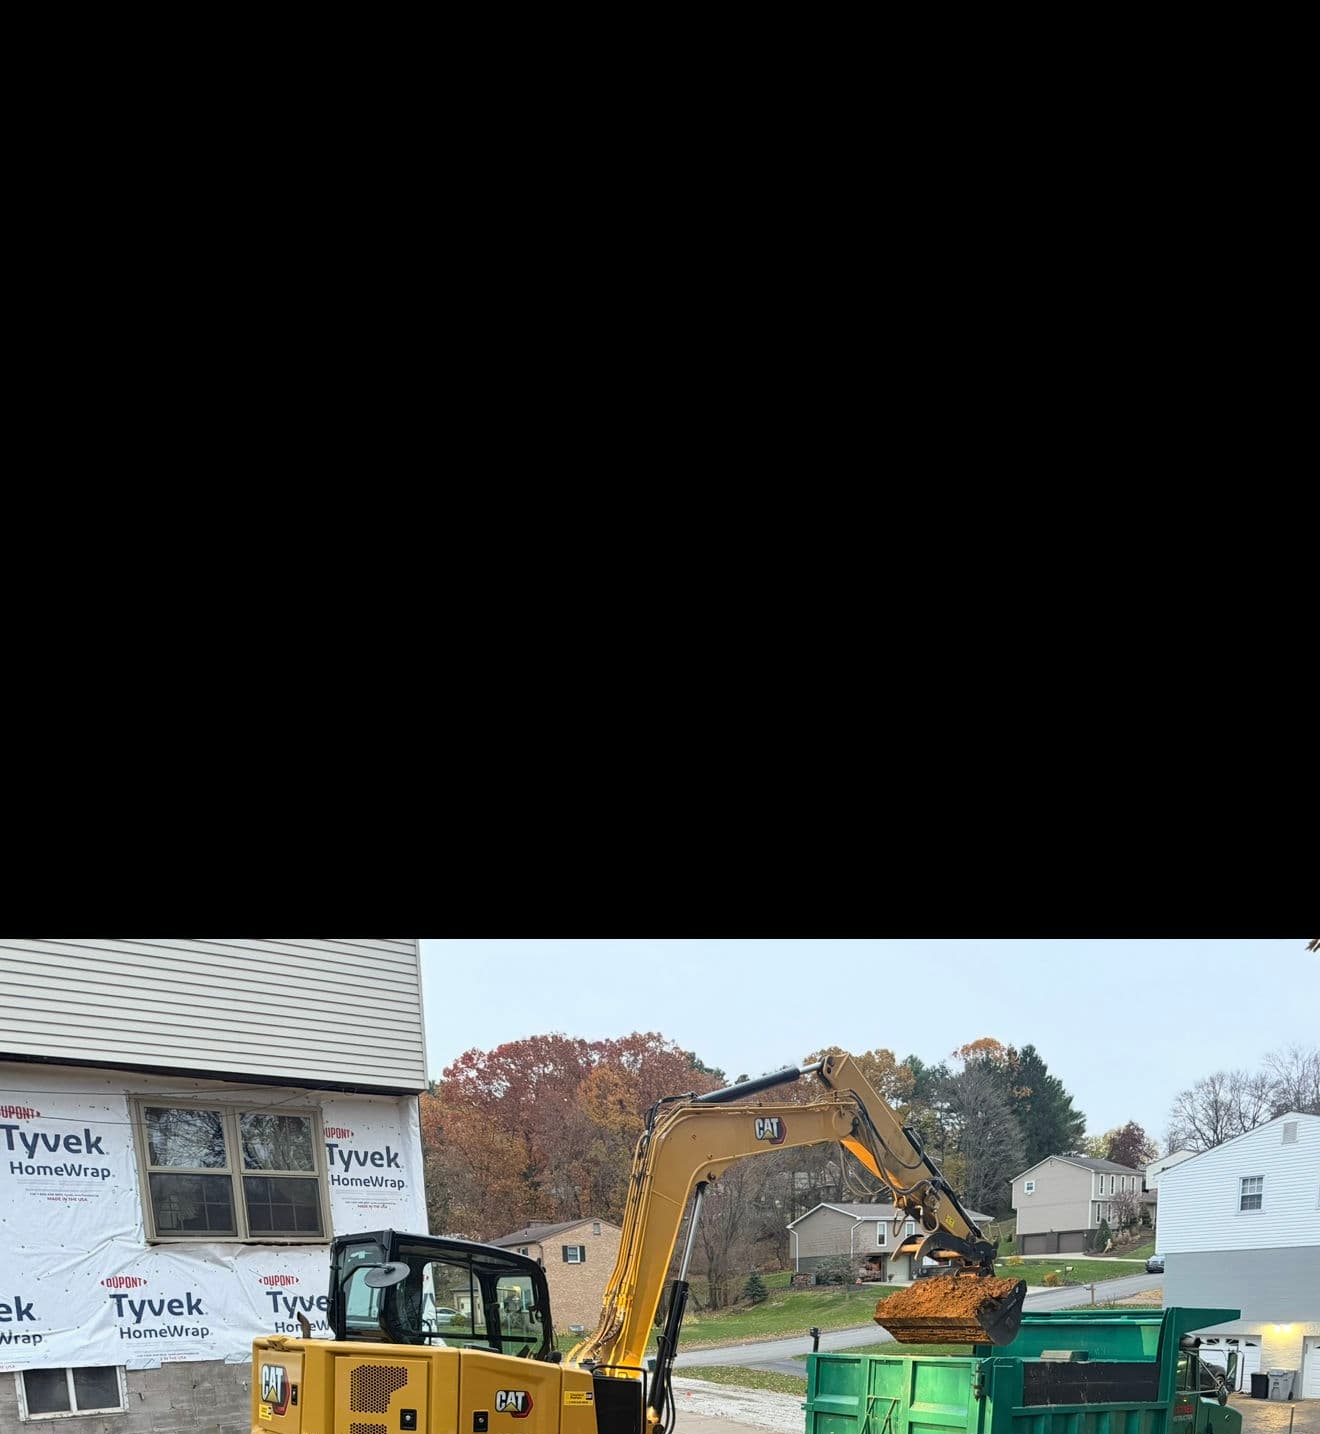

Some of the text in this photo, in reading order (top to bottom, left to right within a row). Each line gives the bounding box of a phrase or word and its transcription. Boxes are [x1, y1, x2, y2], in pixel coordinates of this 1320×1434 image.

[0, 1105, 35, 1120] UPONT
[755, 1118, 779, 1140] CAT
[0, 1124, 105, 1159] Tyvek
[326, 1143, 401, 1172] Tyvek
[10, 1161, 111, 1181] HomeWrap
[331, 1174, 405, 1191] HomeWrap
[106, 1276, 143, 1289] DUPONT
[263, 1275, 295, 1287] DUPONT
[109, 1292, 204, 1324] Tyvek
[266, 1291, 329, 1319] Tyve
[0, 1332, 42, 1346] Wrap
[120, 1324, 209, 1339] HomeWrap
[262, 1365, 284, 1403] CAT
[496, 1390, 525, 1412] CAT
